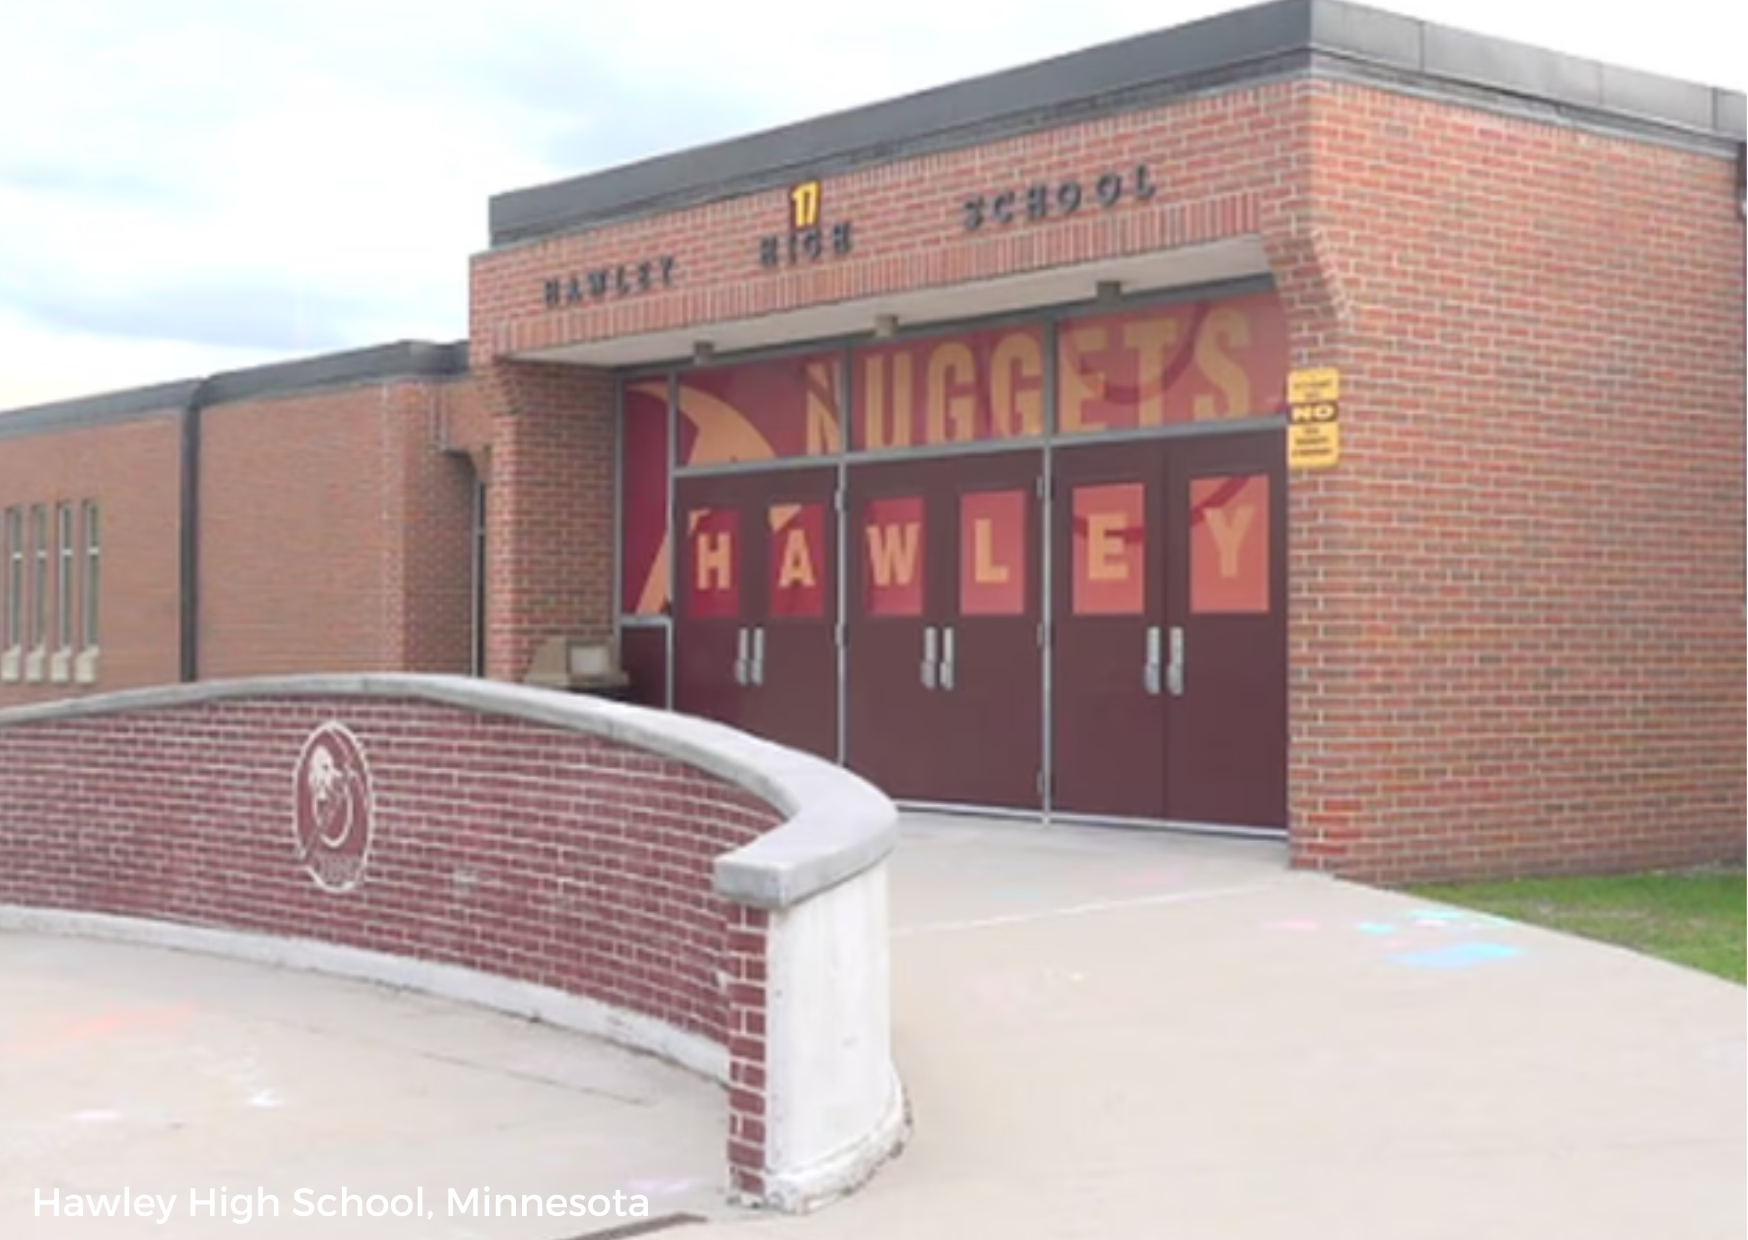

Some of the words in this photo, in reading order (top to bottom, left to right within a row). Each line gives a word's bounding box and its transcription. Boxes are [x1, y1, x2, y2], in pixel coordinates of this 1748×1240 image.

[543, 254, 675, 307] HAWLEY
[760, 221, 852, 267] HIGH
[963, 164, 1157, 231] SCHOOL
[791, 180, 820, 229] 17
[806, 307, 1252, 456] NUGGETS
[1291, 404, 1335, 421] NO
[696, 505, 1255, 590] HAWLEY
